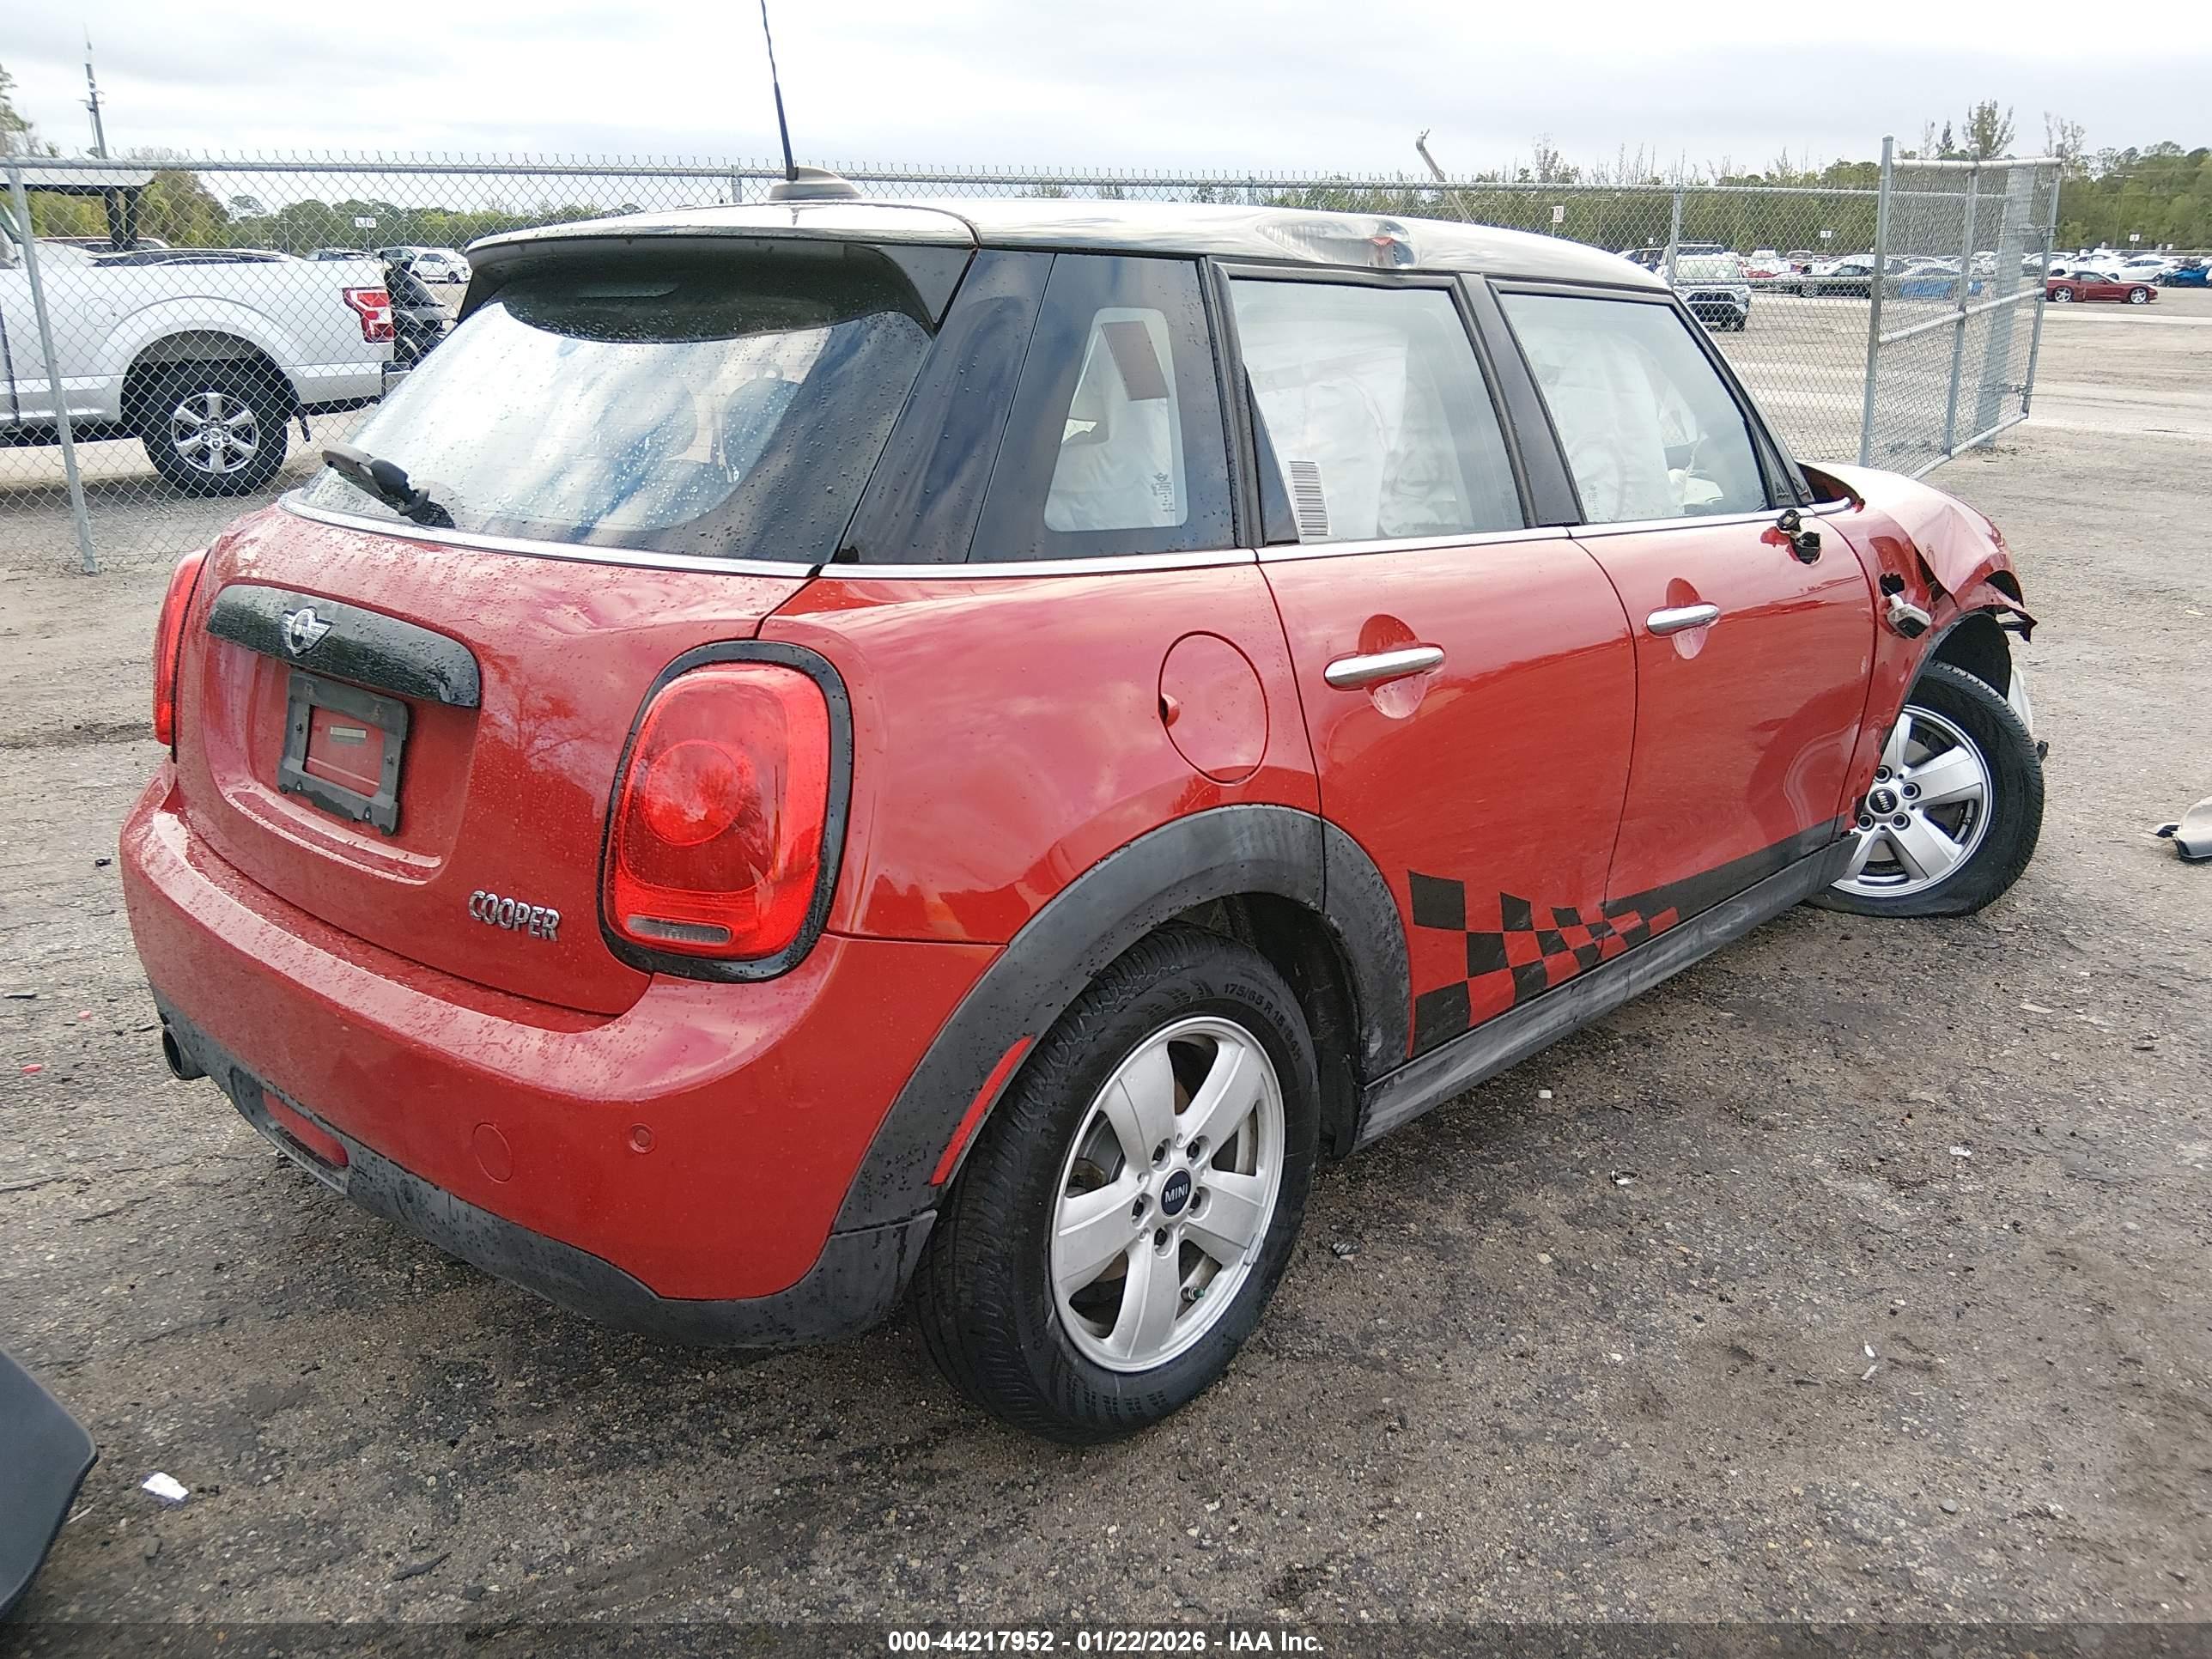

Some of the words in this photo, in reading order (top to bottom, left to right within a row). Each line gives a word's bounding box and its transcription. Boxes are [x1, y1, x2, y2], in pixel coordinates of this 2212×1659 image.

[1875, 791, 1891, 811] MINI
[468, 890, 560, 942] COOPER
[1224, 982, 1265, 1006] 175/65
[1264, 1000, 1273, 1014] R
[1164, 1182, 1188, 1203] MINI
